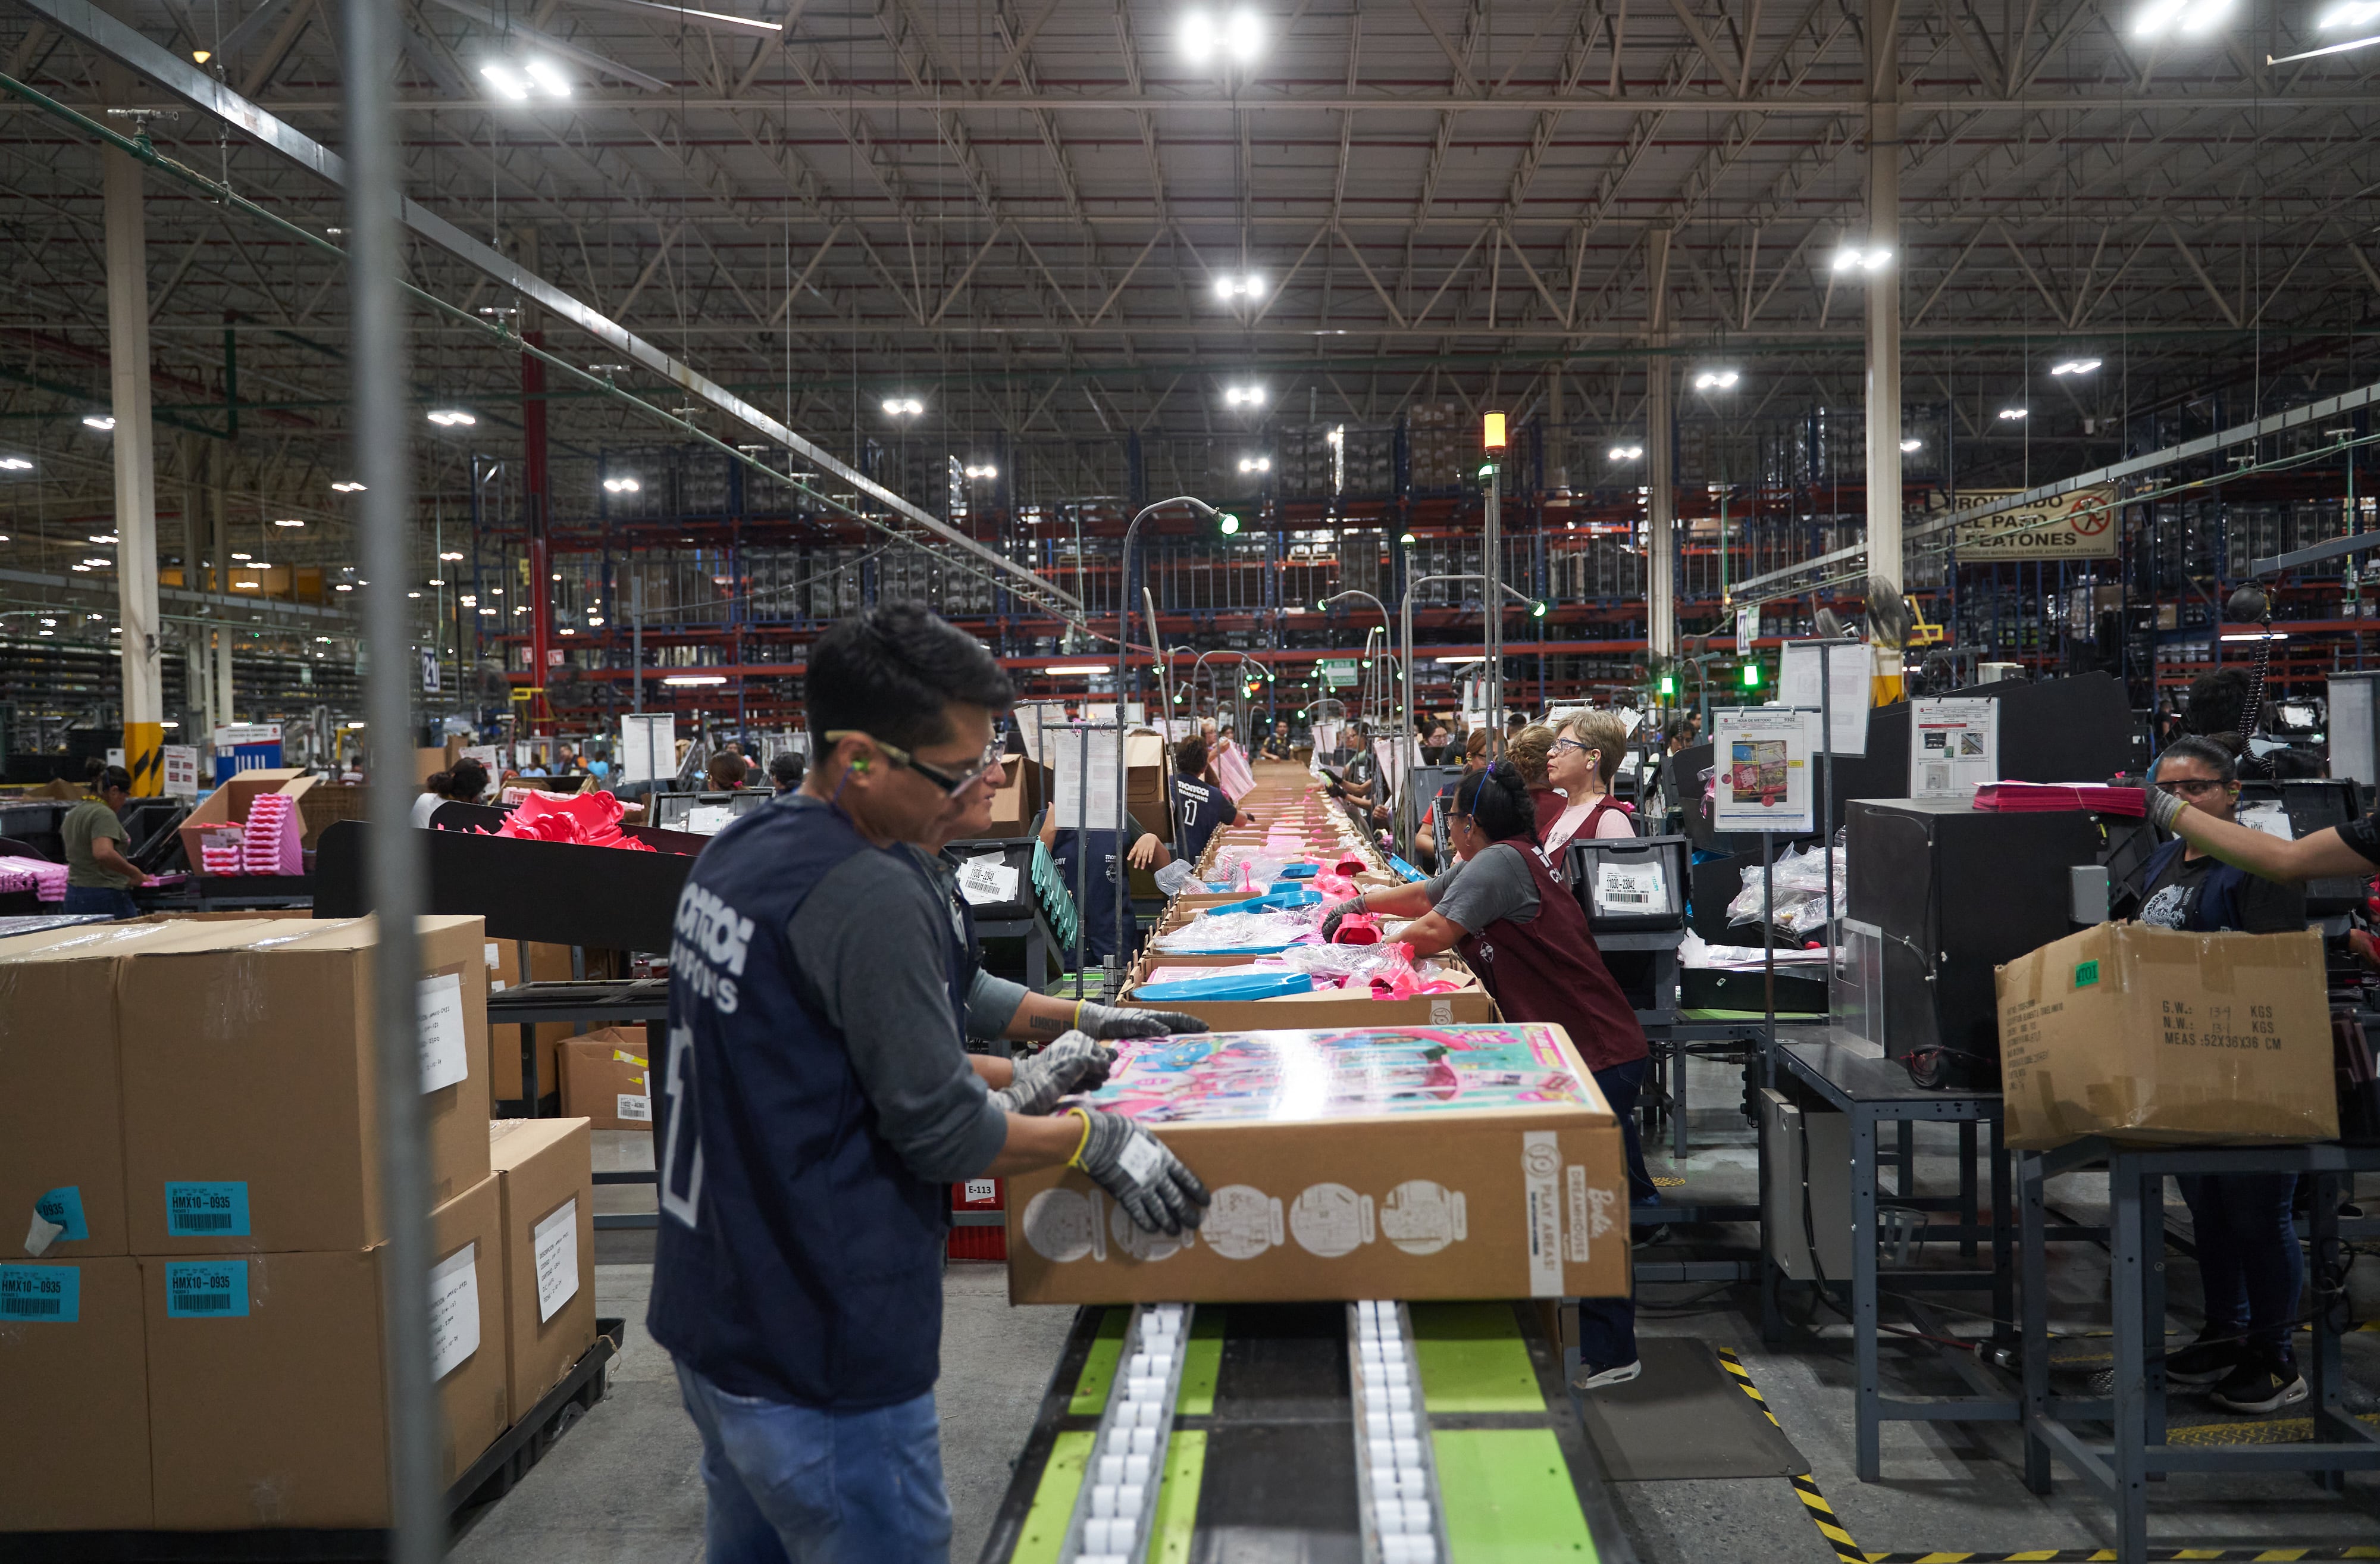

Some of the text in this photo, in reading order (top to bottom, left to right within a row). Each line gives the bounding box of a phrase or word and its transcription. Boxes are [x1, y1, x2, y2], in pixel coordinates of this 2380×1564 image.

[1184, 799, 1197, 826] 1
[2162, 1000, 2192, 1014] G.W.:
[2250, 1005, 2273, 1018] KGS
[2163, 1016, 2194, 1030] N.W.:
[2251, 1021, 2275, 1034] KGS
[2265, 1037, 2281, 1050] CM
[969, 1185, 991, 1194] E-113
